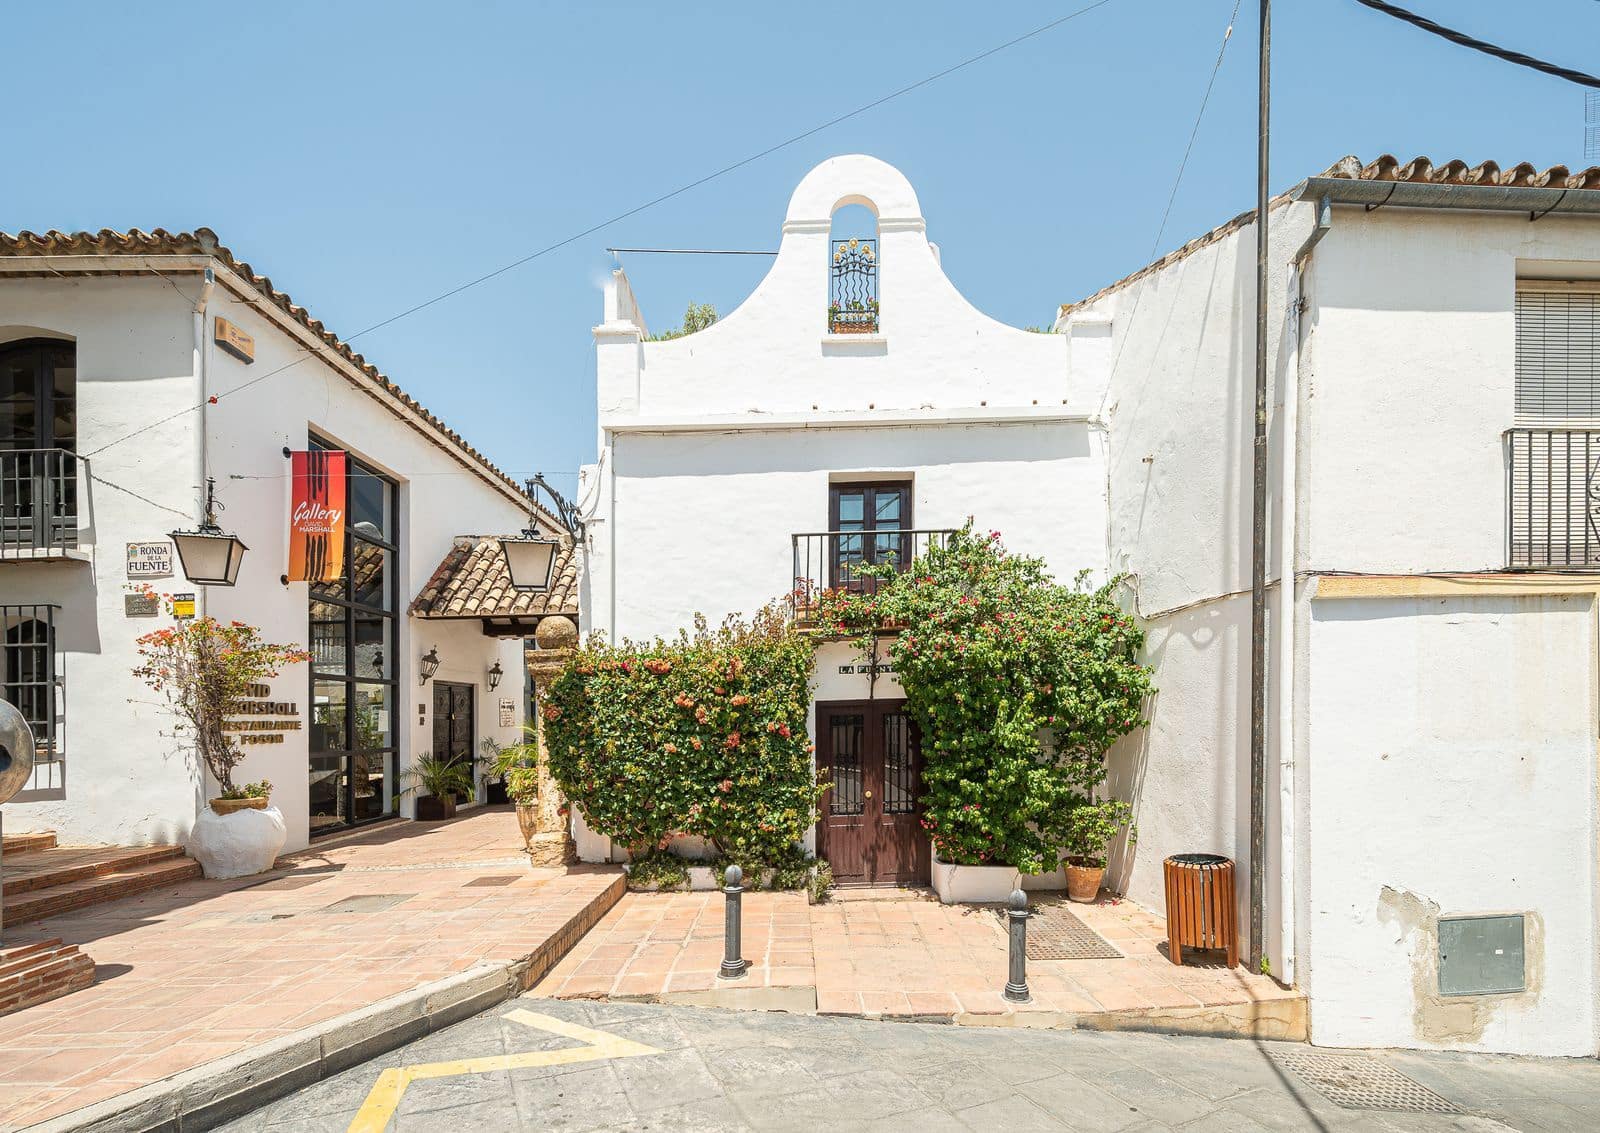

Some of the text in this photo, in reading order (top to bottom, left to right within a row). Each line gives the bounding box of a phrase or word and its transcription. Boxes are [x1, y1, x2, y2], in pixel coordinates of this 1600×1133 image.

[294, 501, 342, 526] Gallery
[140, 546, 168, 555] RONDA
[129, 561, 169, 571] FUENTE
